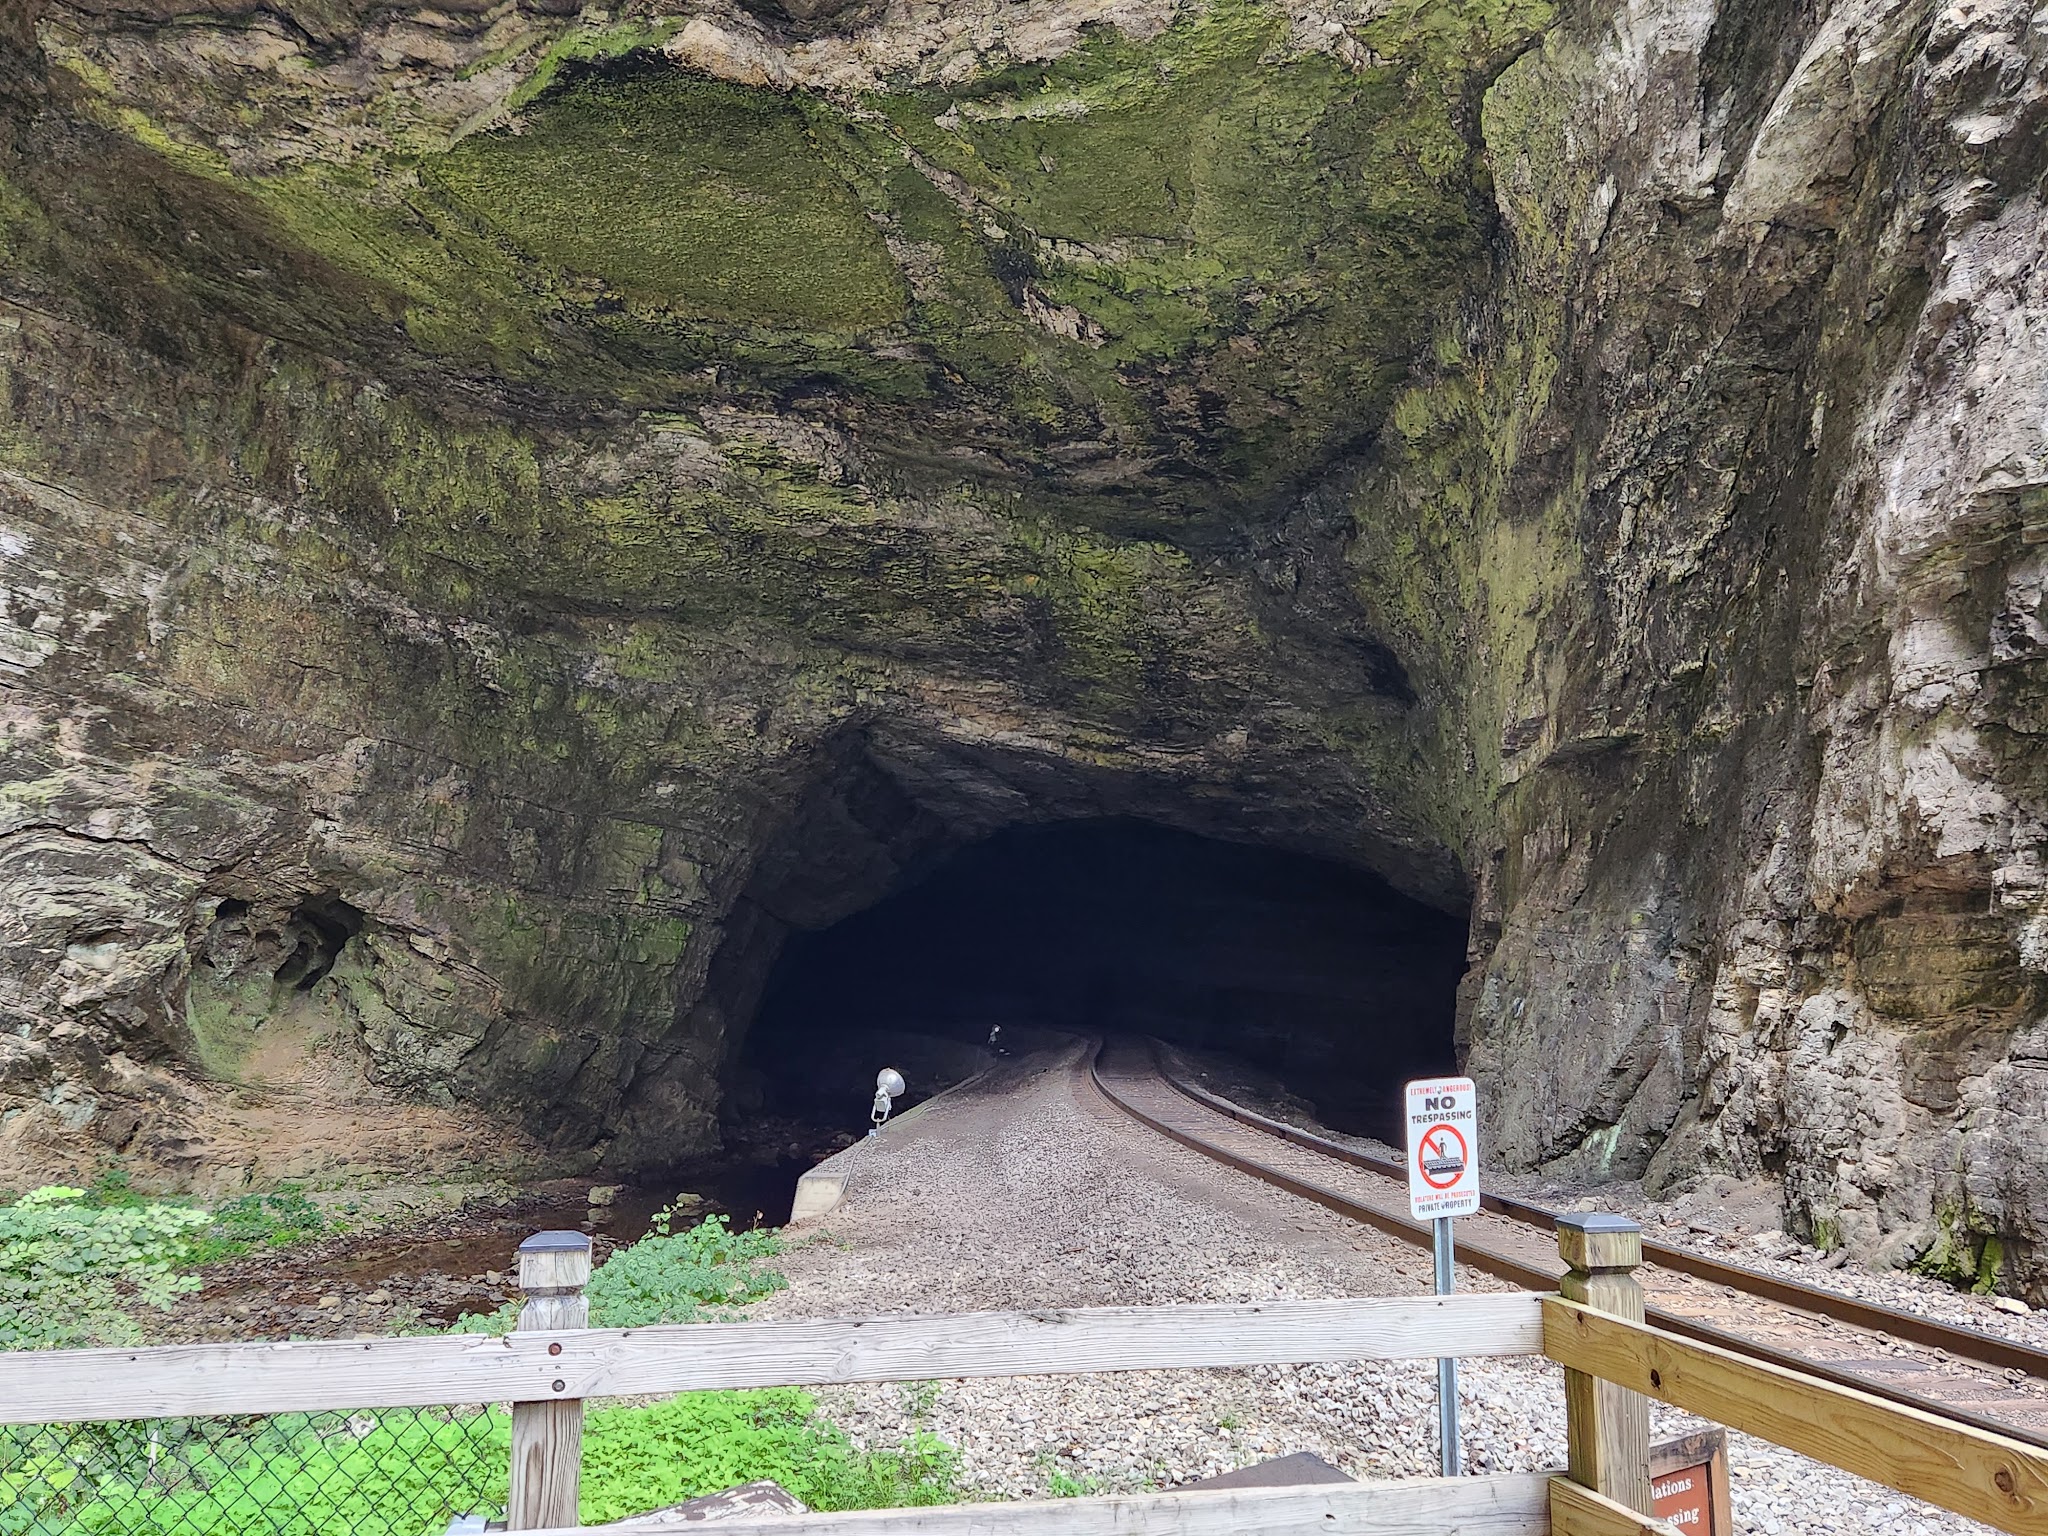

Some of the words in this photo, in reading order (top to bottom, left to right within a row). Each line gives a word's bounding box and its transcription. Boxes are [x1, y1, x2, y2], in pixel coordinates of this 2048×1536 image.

[1425, 1096, 1456, 1111] NO
[1411, 1110, 1472, 1124] TRESPASSING
[1418, 1203, 1440, 1213] PRIVATE
